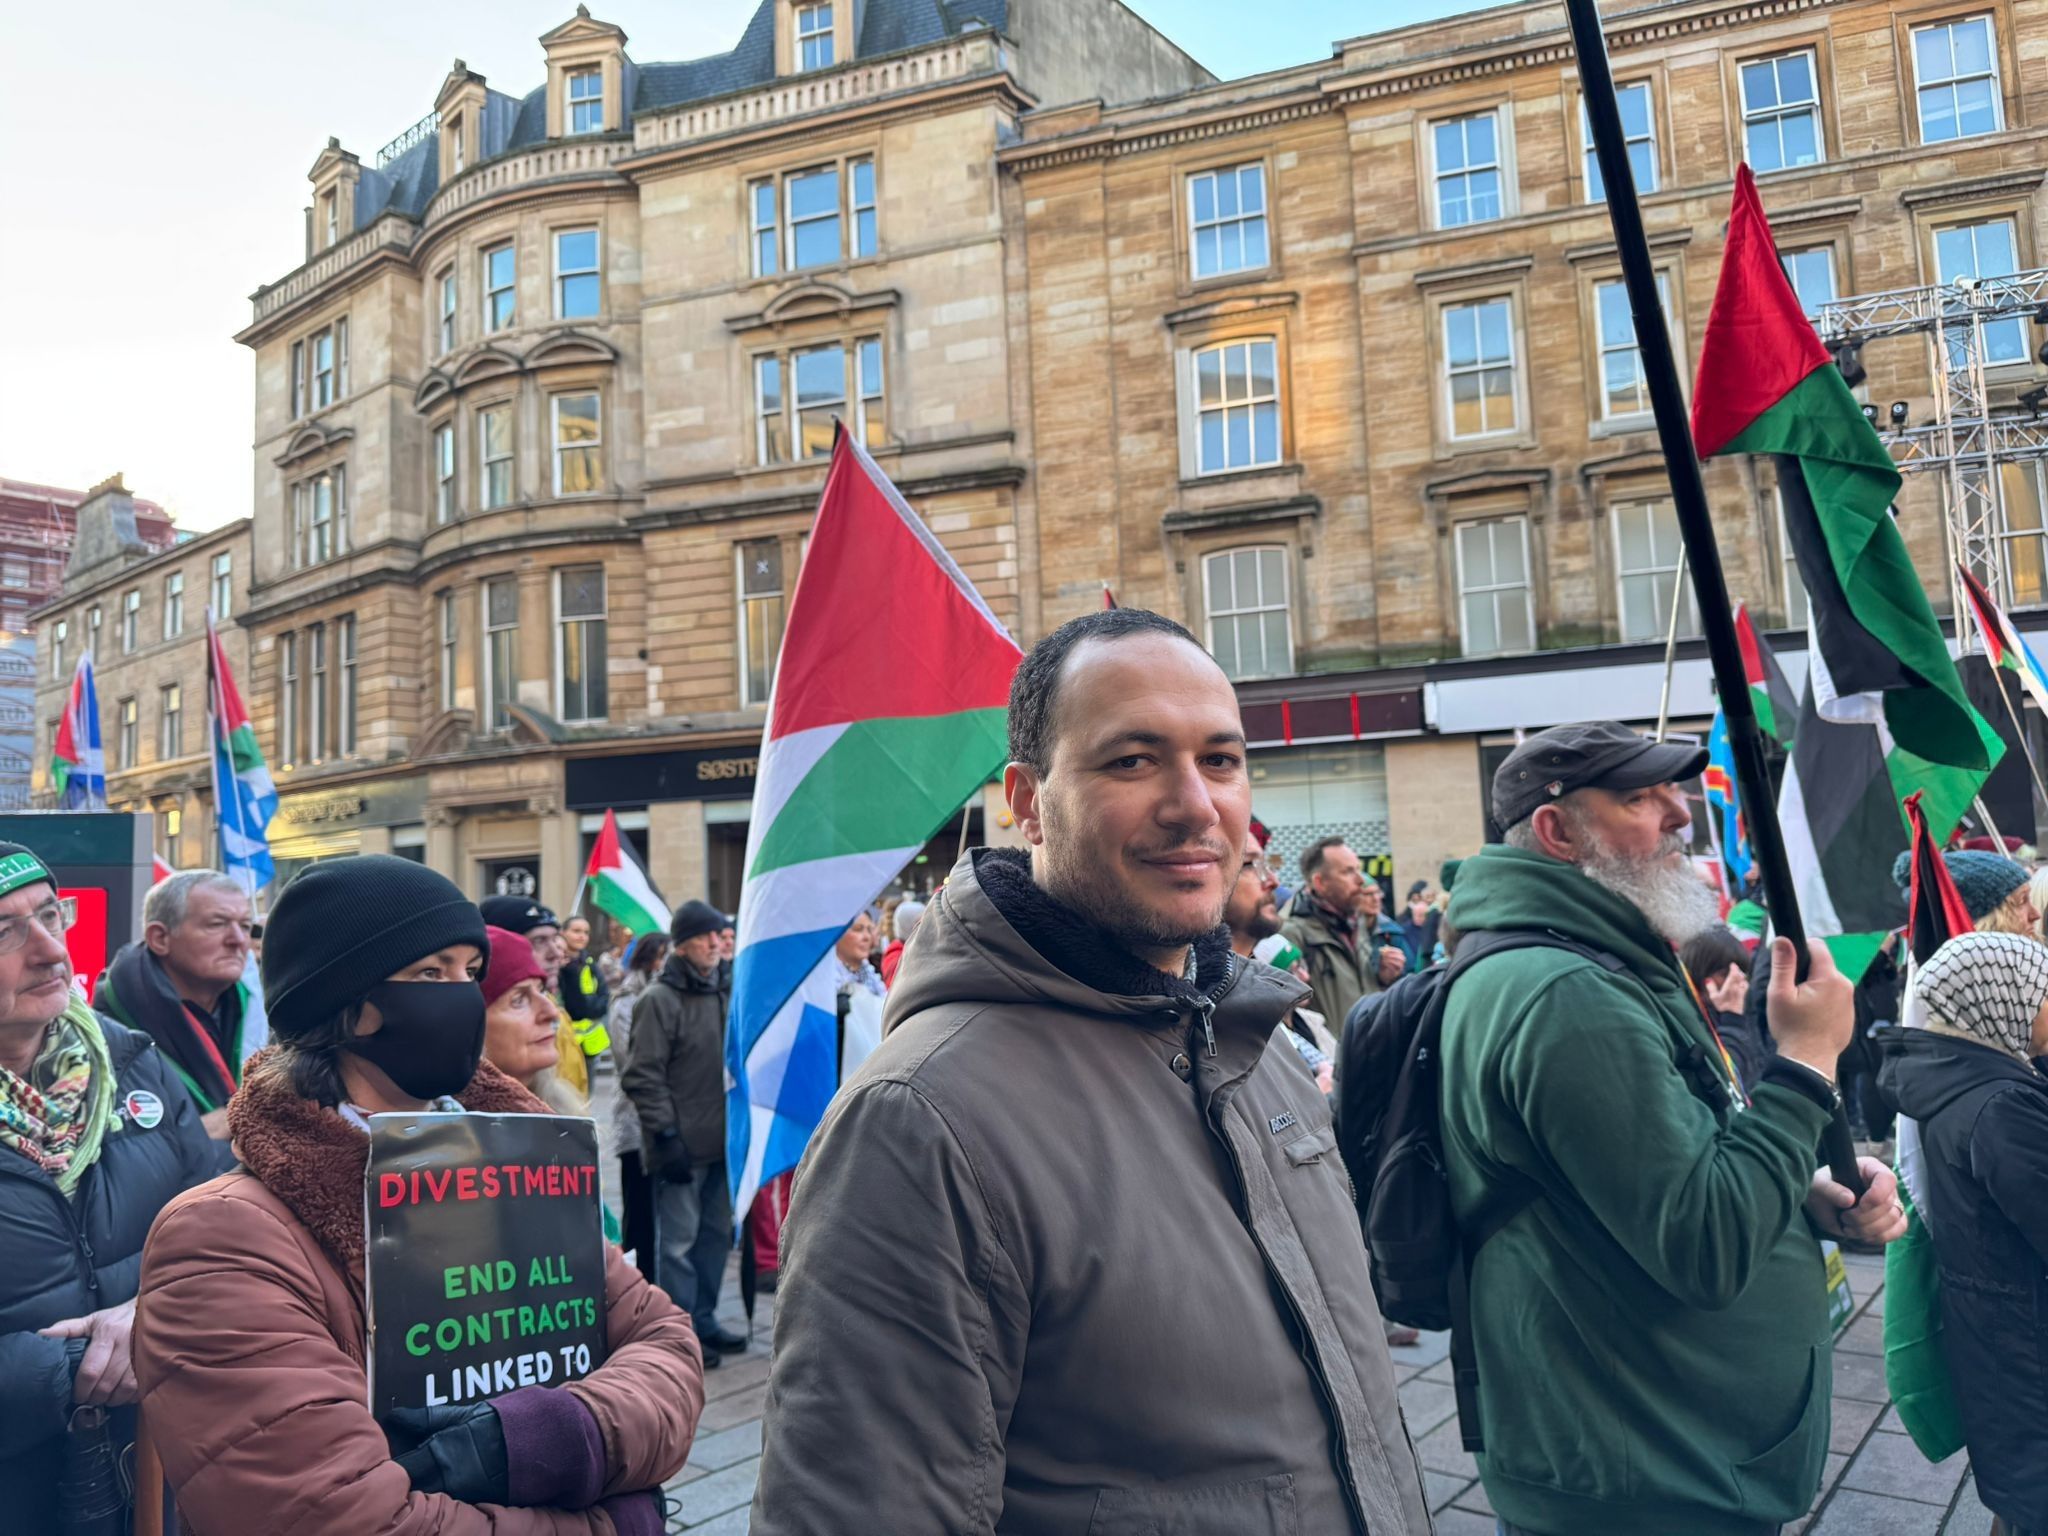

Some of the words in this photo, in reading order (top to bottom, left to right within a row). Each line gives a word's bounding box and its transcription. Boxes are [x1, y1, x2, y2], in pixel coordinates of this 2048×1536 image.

[380, 1165, 596, 1207] DIVESTMENT
[444, 1260, 516, 1299] END
[528, 1255, 573, 1287] ALL
[405, 1297, 596, 1356] CONTRACTS
[425, 1351, 553, 1407] LINKED
[560, 1343, 591, 1377] TO
